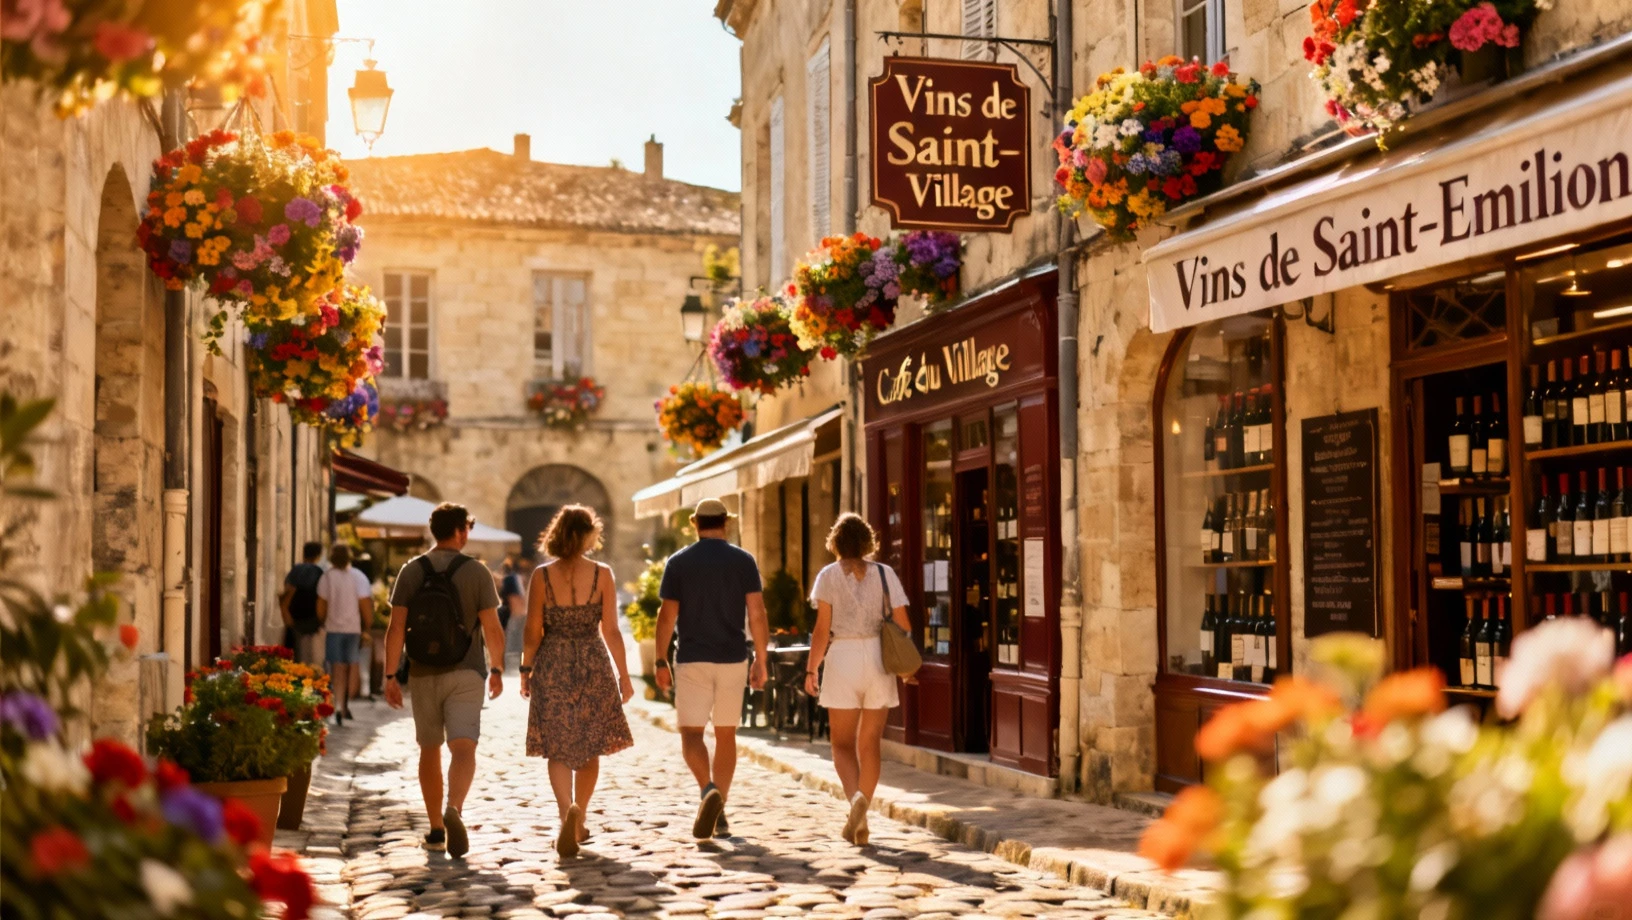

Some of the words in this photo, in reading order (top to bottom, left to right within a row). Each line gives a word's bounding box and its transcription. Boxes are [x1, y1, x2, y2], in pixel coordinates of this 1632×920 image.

[894, 74, 972, 117] Vins
[981, 81, 1017, 119] de
[887, 121, 1020, 168] Saint-
[905, 172, 1014, 220] Village
[1173, 255, 1247, 310] Vins
[1259, 232, 1301, 291] de
[1313, 148, 1632, 277] Saint-Emilion
[915, 351, 941, 394] du
[942, 336, 1011, 388] Village
